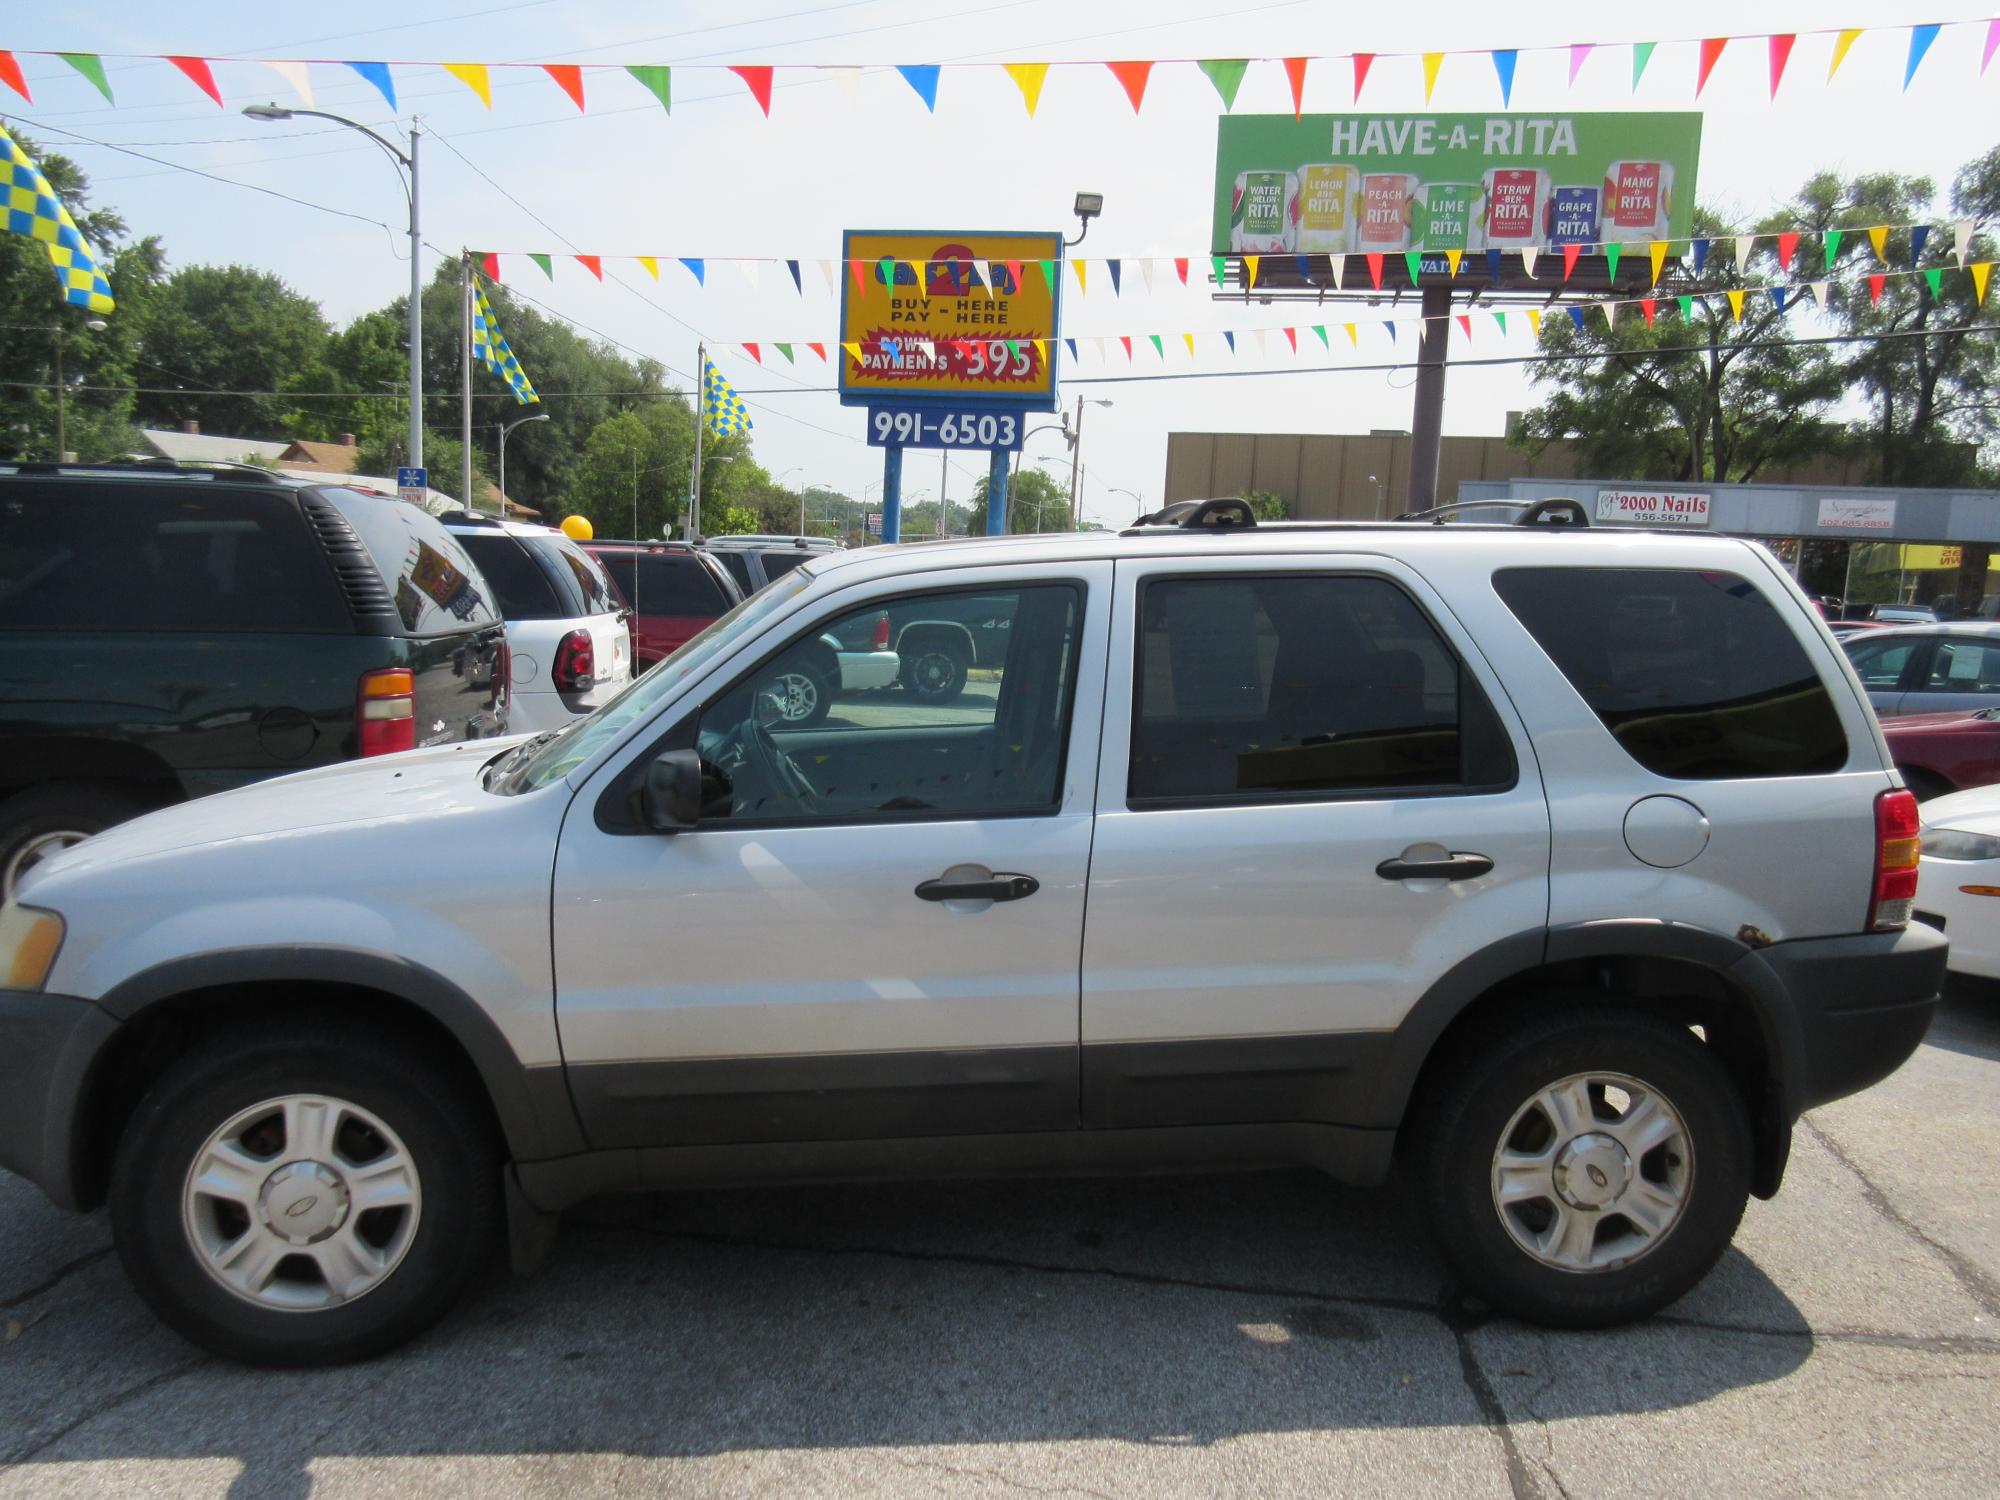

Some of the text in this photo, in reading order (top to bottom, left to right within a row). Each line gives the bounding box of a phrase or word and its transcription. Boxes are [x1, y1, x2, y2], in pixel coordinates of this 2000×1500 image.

[1331, 119, 1578, 156] HAVE-A-RITA
[1309, 179, 1342, 190] LEMON
[1496, 184, 1531, 195] STRAW
[1622, 176, 1654, 189] MANG
[1250, 185, 1281, 196] WATER
[1368, 189, 1402, 200] PEACH
[1308, 198, 1340, 213] RITA
[1431, 199, 1465, 213] LIME
[1558, 202, 1593, 213] GRAPE
[1620, 195, 1652, 209] RITA
[1248, 203, 1279, 218] RITA
[1366, 208, 1400, 224] RITA
[1494, 203, 1529, 219] RITA
[1430, 220, 1462, 236] RITA
[1556, 221, 1590, 236] RITA
[926, 243, 974, 296] 2
[891, 298, 931, 310] BUY
[957, 300, 1008, 311] HERE
[891, 311, 1008, 324] PAY HERE
[874, 411, 1016, 446] 991-6503
[1620, 495, 1707, 513] 2000 Nails
[1634, 512, 1689, 522] 556-5671
